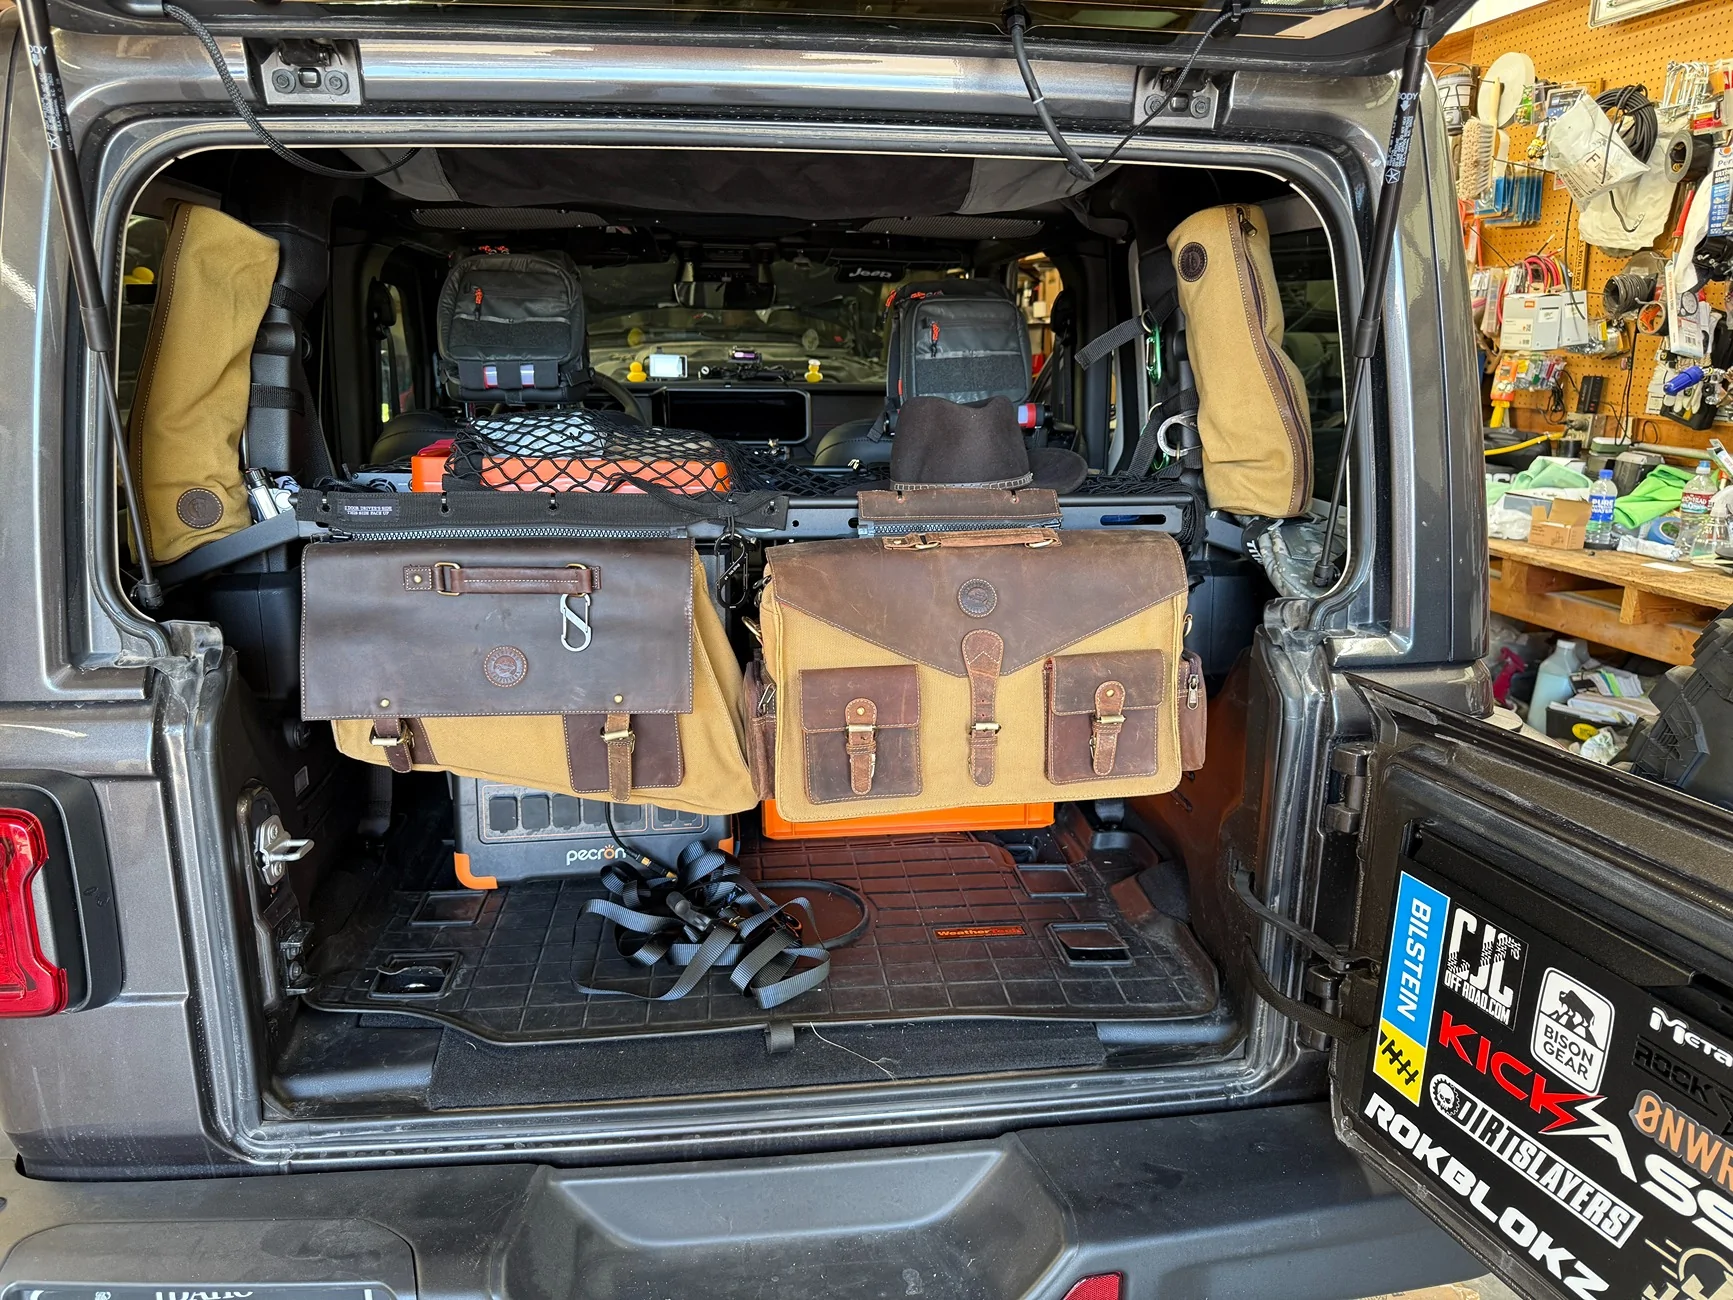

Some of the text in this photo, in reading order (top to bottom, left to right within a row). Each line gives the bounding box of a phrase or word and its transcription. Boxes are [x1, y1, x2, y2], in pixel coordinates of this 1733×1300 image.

[848, 267, 892, 278] Jeep
[566, 847, 626, 866] pecron
[1397, 898, 1431, 1022] BILSTEIN
[1444, 970, 1461, 992] OFF
[1543, 1041, 1588, 1081] GEAR
[1544, 1024, 1594, 1067] BISON
[1364, 1092, 1610, 1300] ROKBLOKZ
